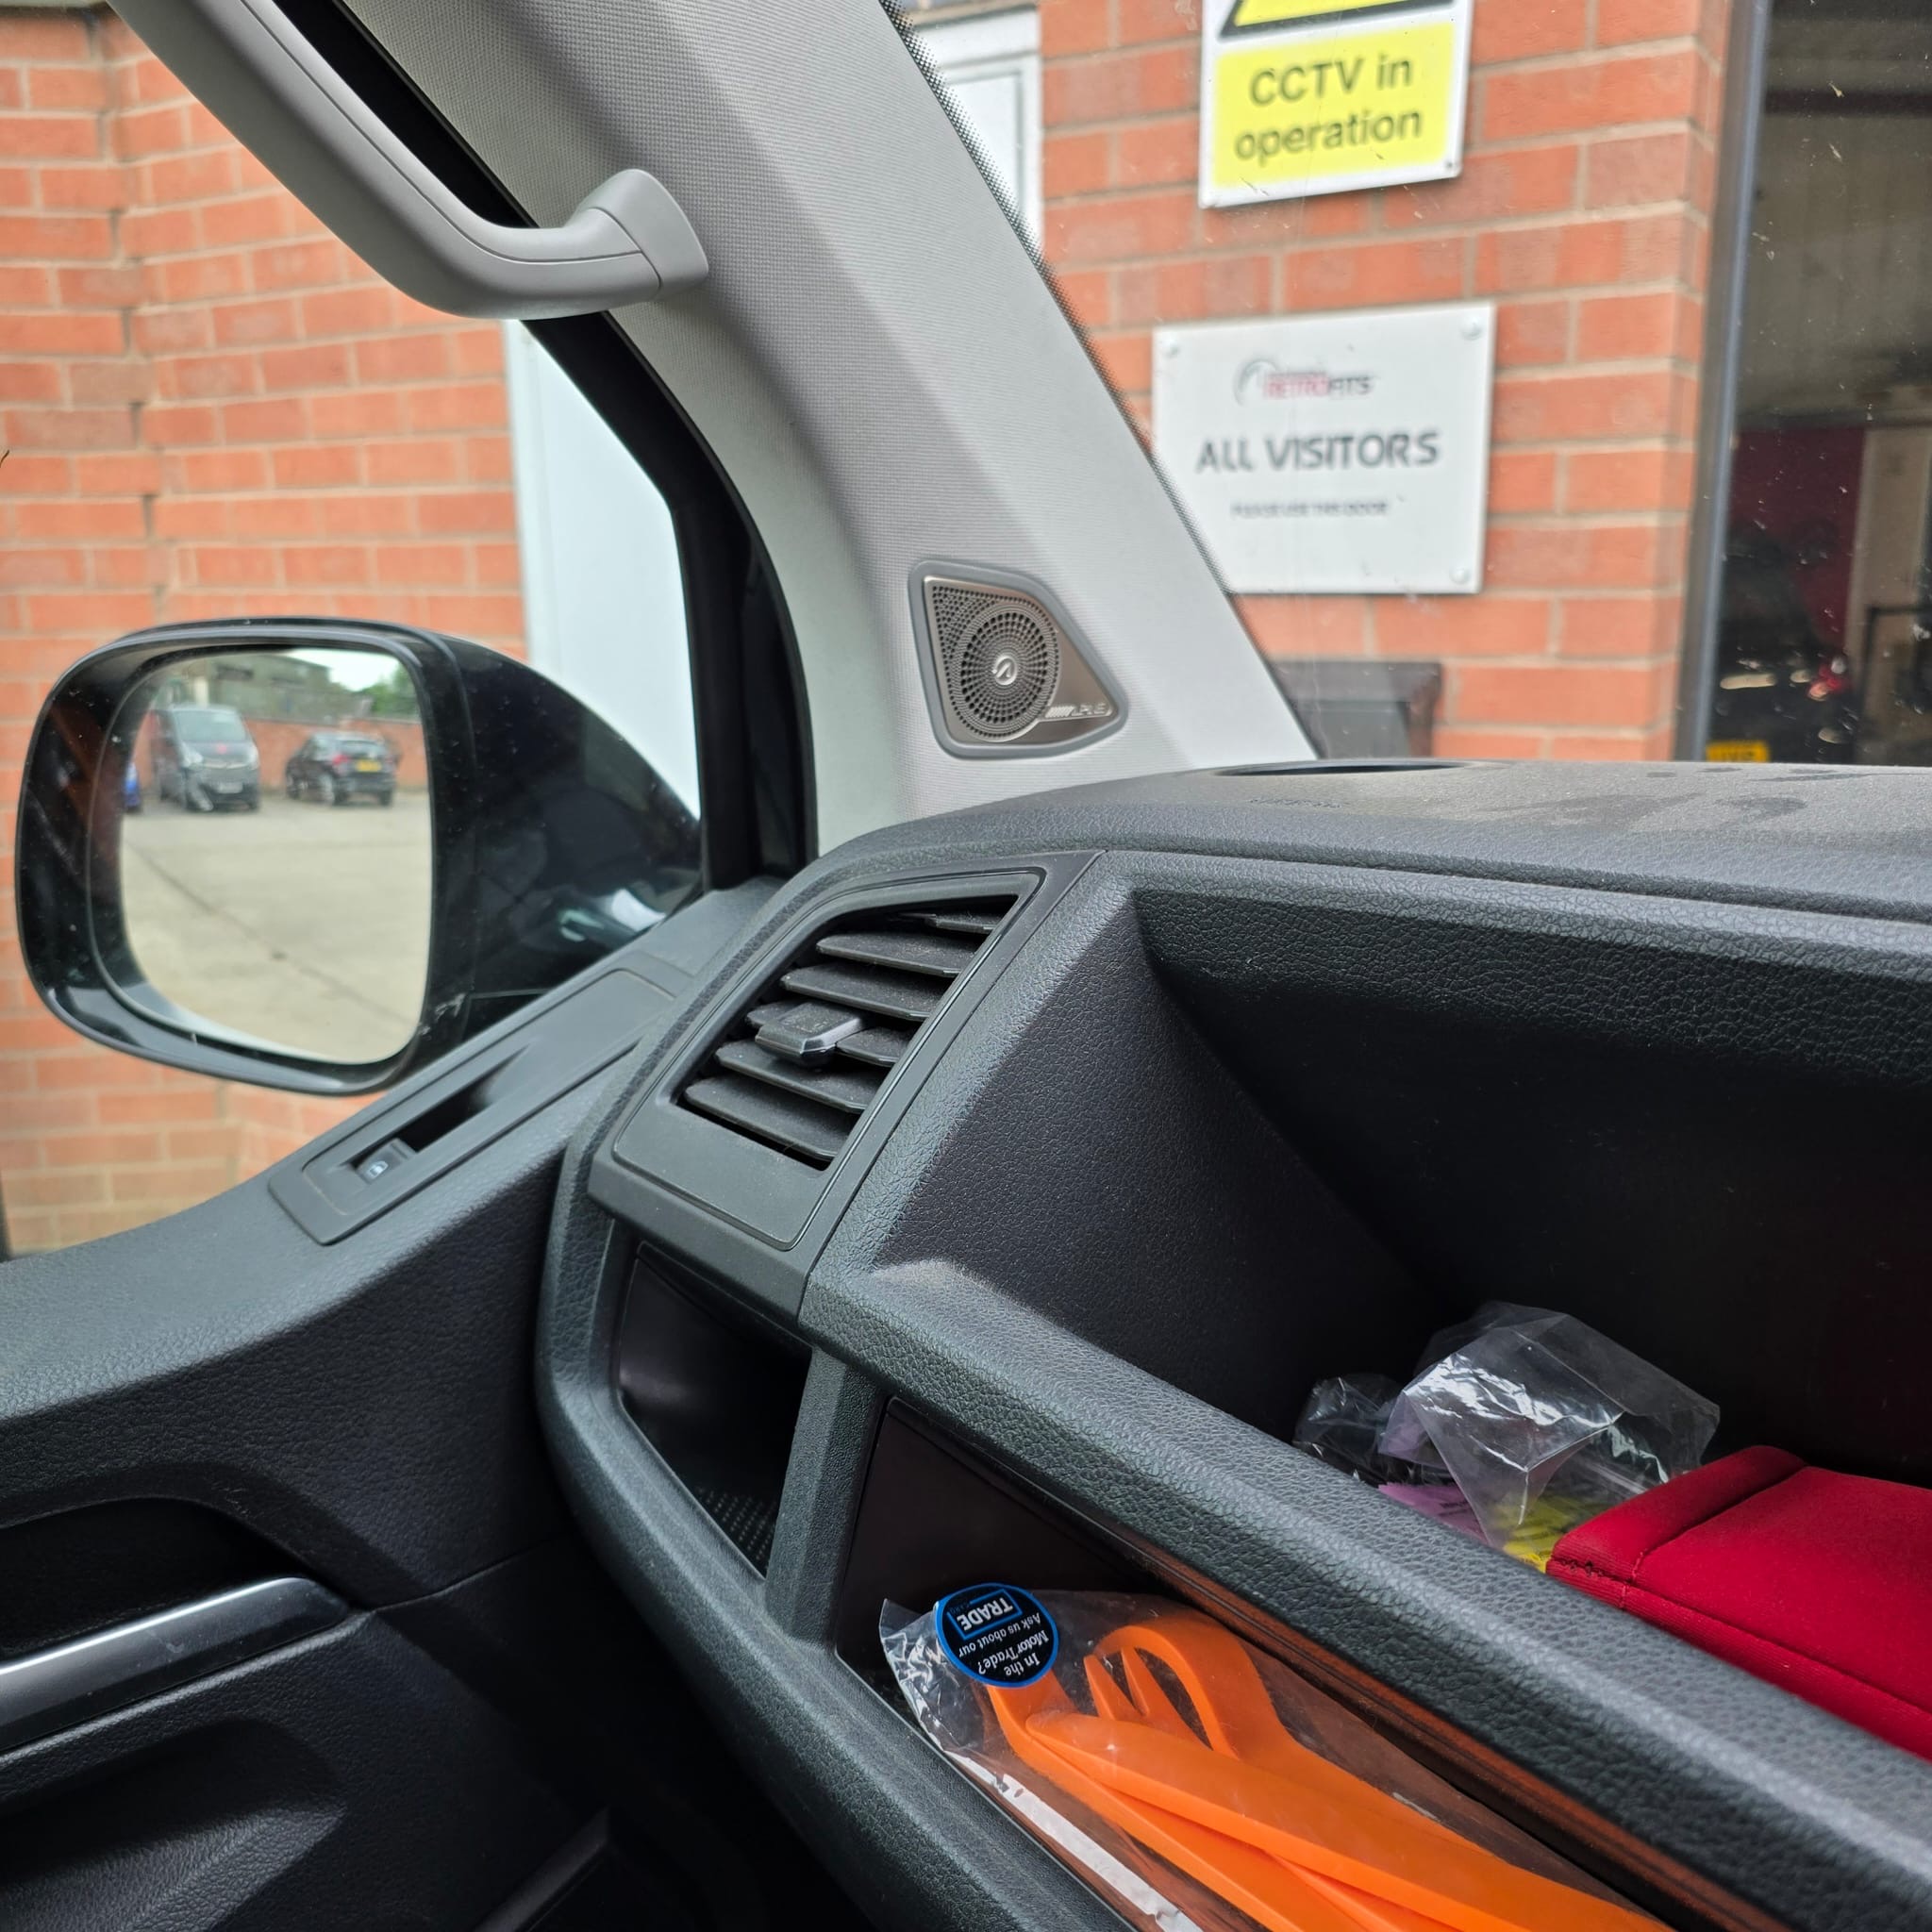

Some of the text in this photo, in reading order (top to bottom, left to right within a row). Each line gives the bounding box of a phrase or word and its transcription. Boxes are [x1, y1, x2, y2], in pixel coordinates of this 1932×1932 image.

[1249, 54, 1413, 107] CCTV in
[1234, 109, 1423, 167] operation
[1195, 430, 1441, 473] ALL VISITORS
[957, 1597, 1014, 1631] TRADE
[958, 1612, 1041, 1658] Ask us about our
[1004, 1652, 1041, 1676] In the
